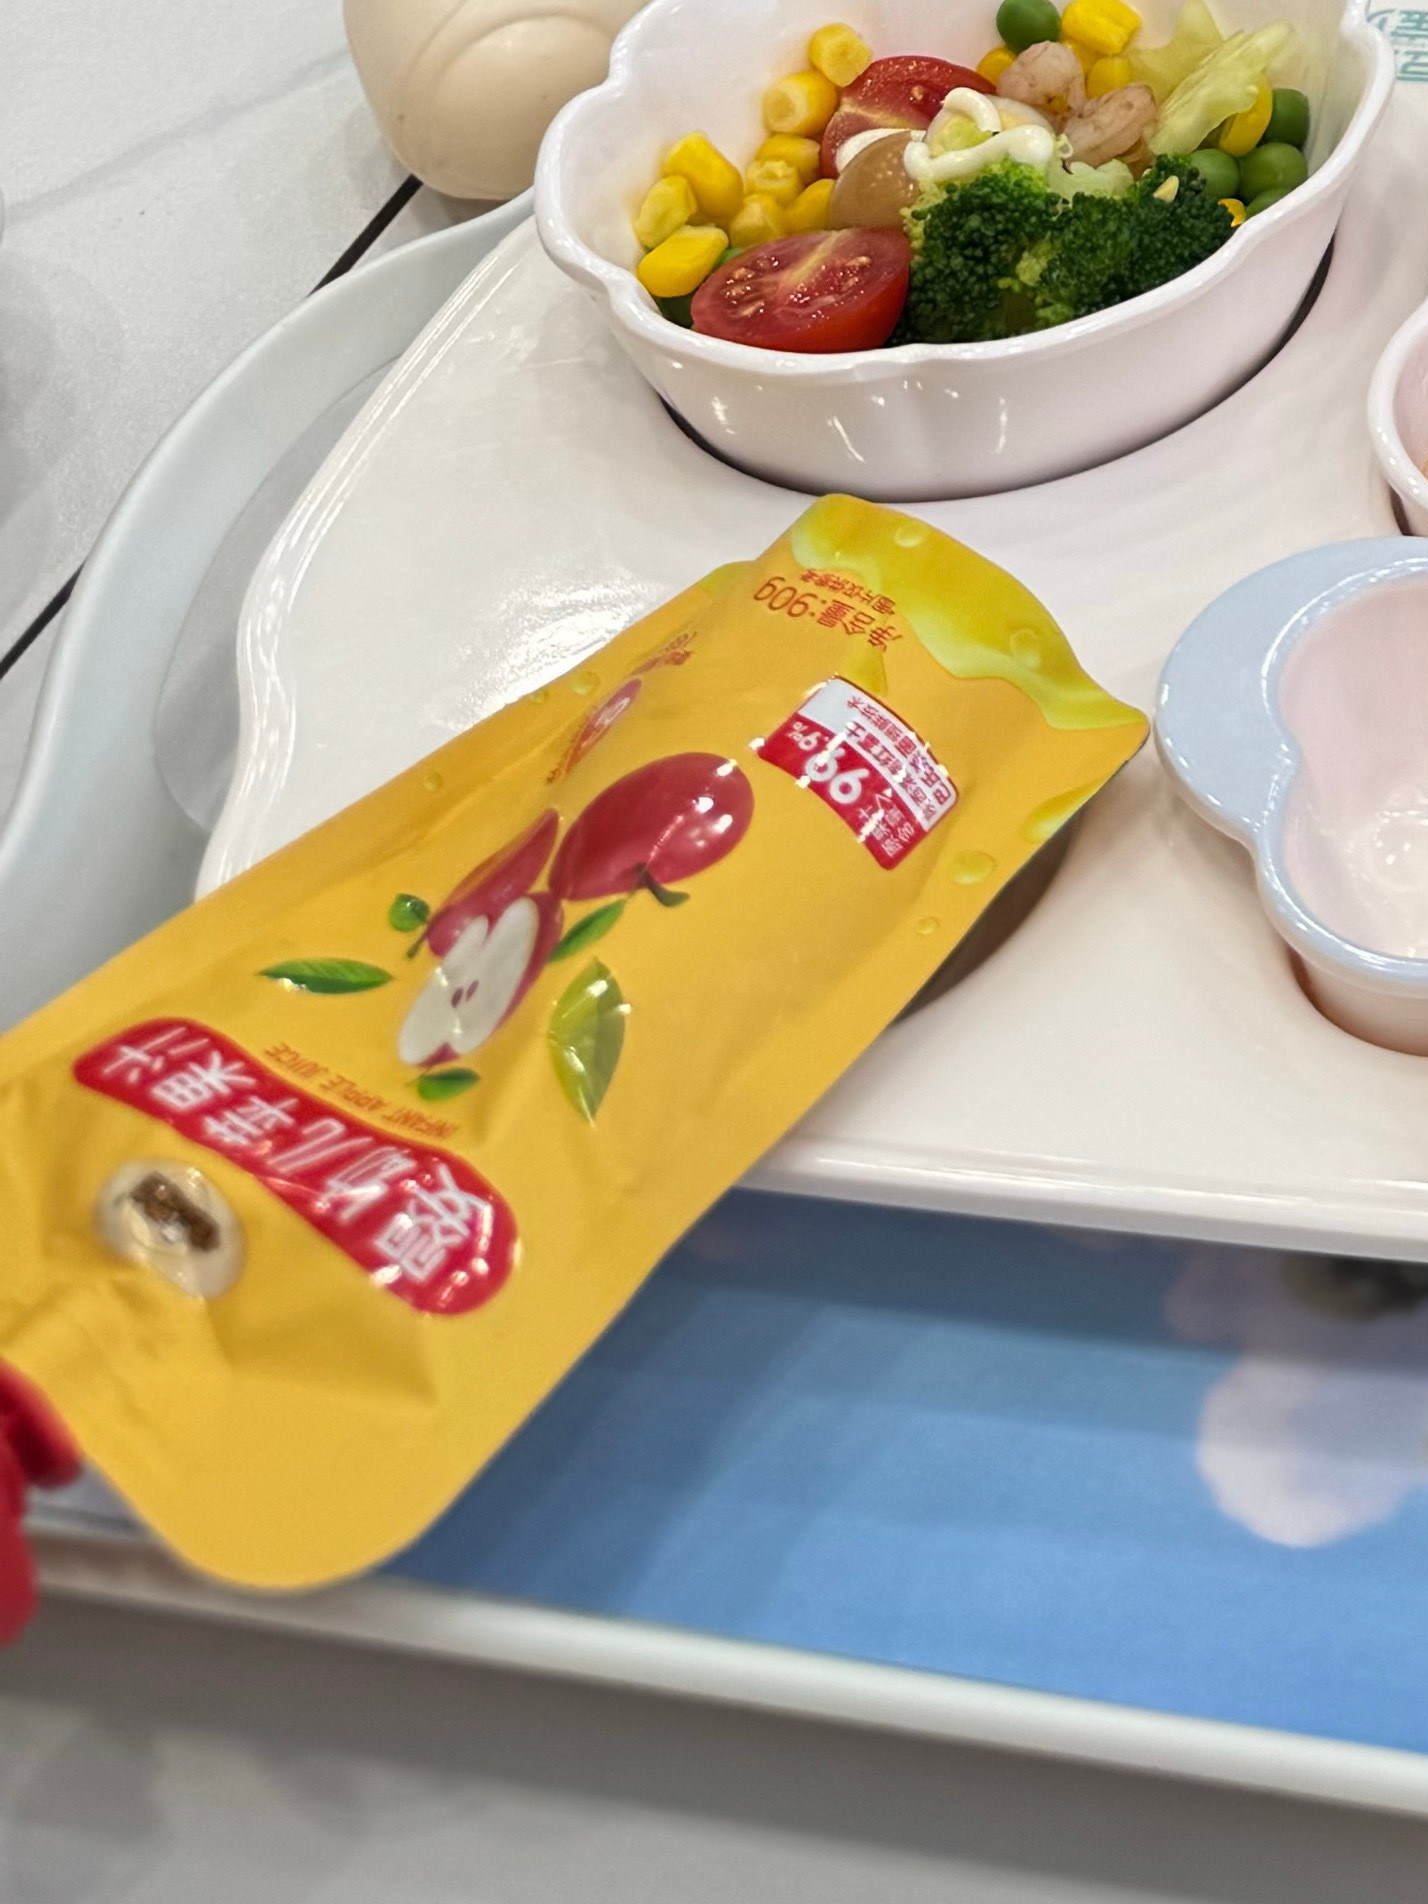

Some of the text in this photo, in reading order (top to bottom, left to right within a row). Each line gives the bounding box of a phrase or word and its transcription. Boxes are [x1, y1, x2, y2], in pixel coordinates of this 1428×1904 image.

[753, 576, 902, 651] 净含量:90g
[263, 1042, 459, 1140] INFANT APPLE JUICE
[103, 1026, 493, 1283] 婴幼儿苹果汁
